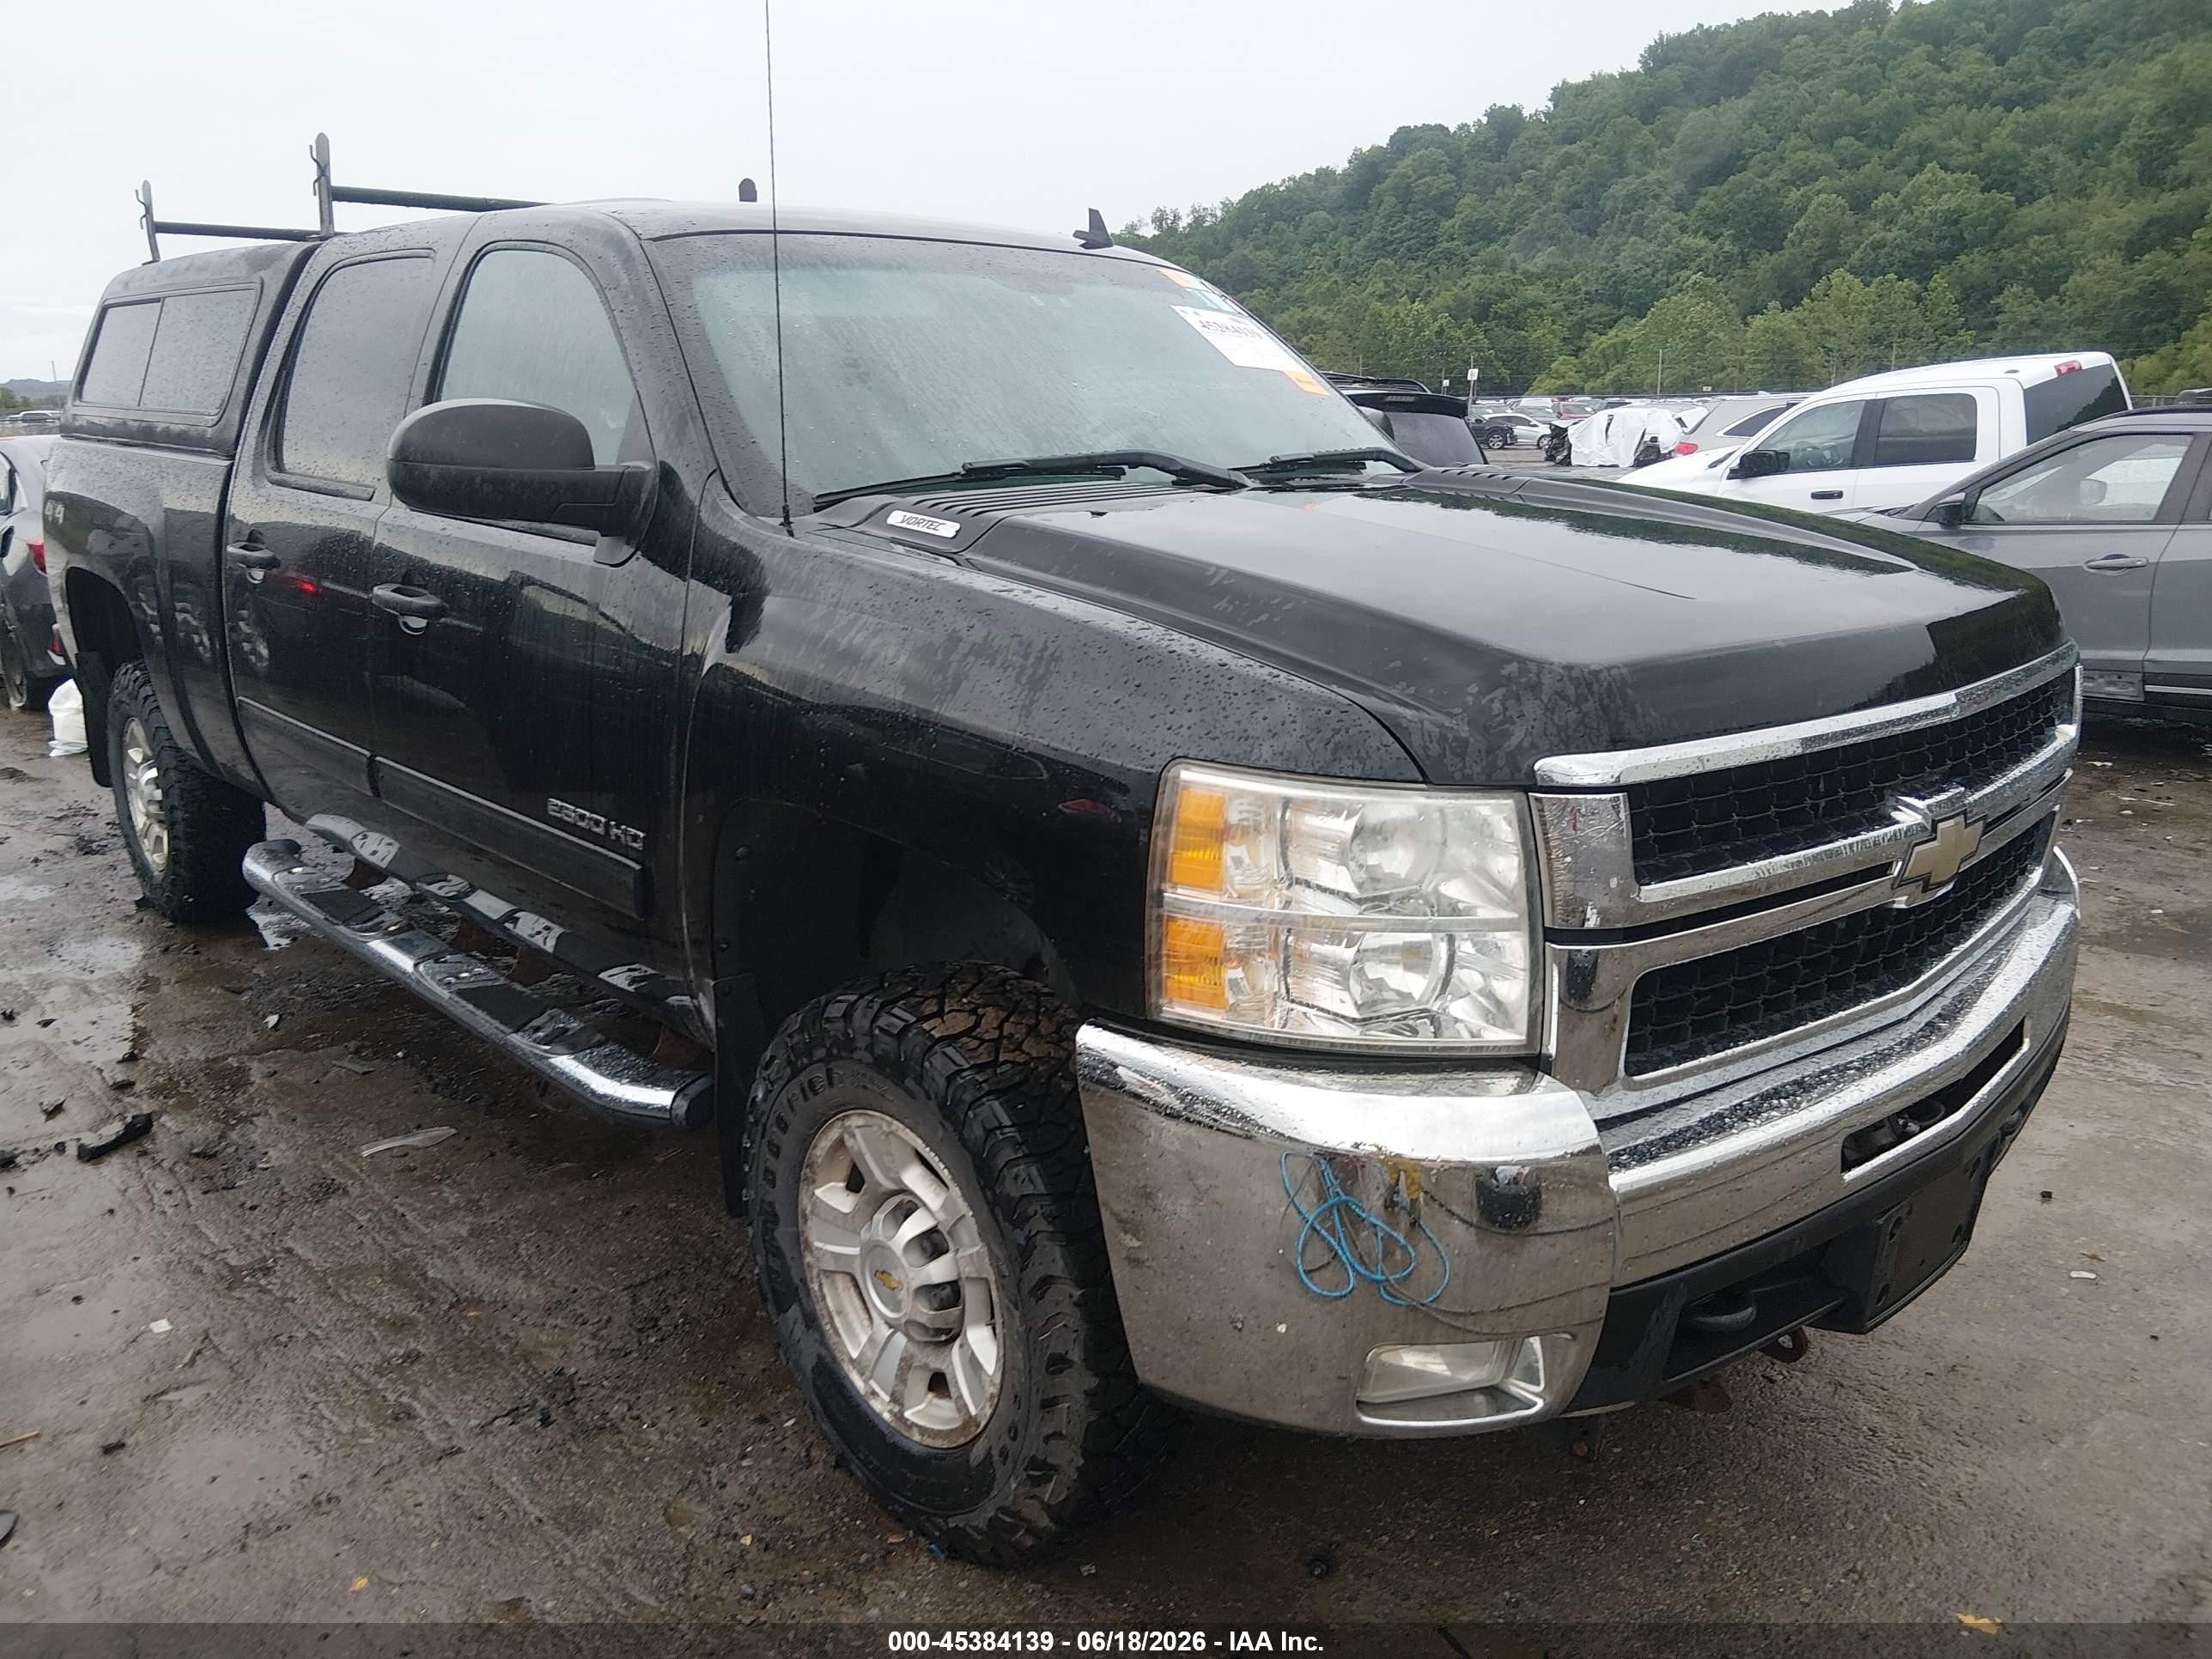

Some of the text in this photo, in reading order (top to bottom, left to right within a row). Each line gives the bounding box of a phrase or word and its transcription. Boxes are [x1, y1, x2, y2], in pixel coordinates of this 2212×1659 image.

[896, 514, 946, 532] VORTEC
[547, 797, 646, 851] 2500 HD
